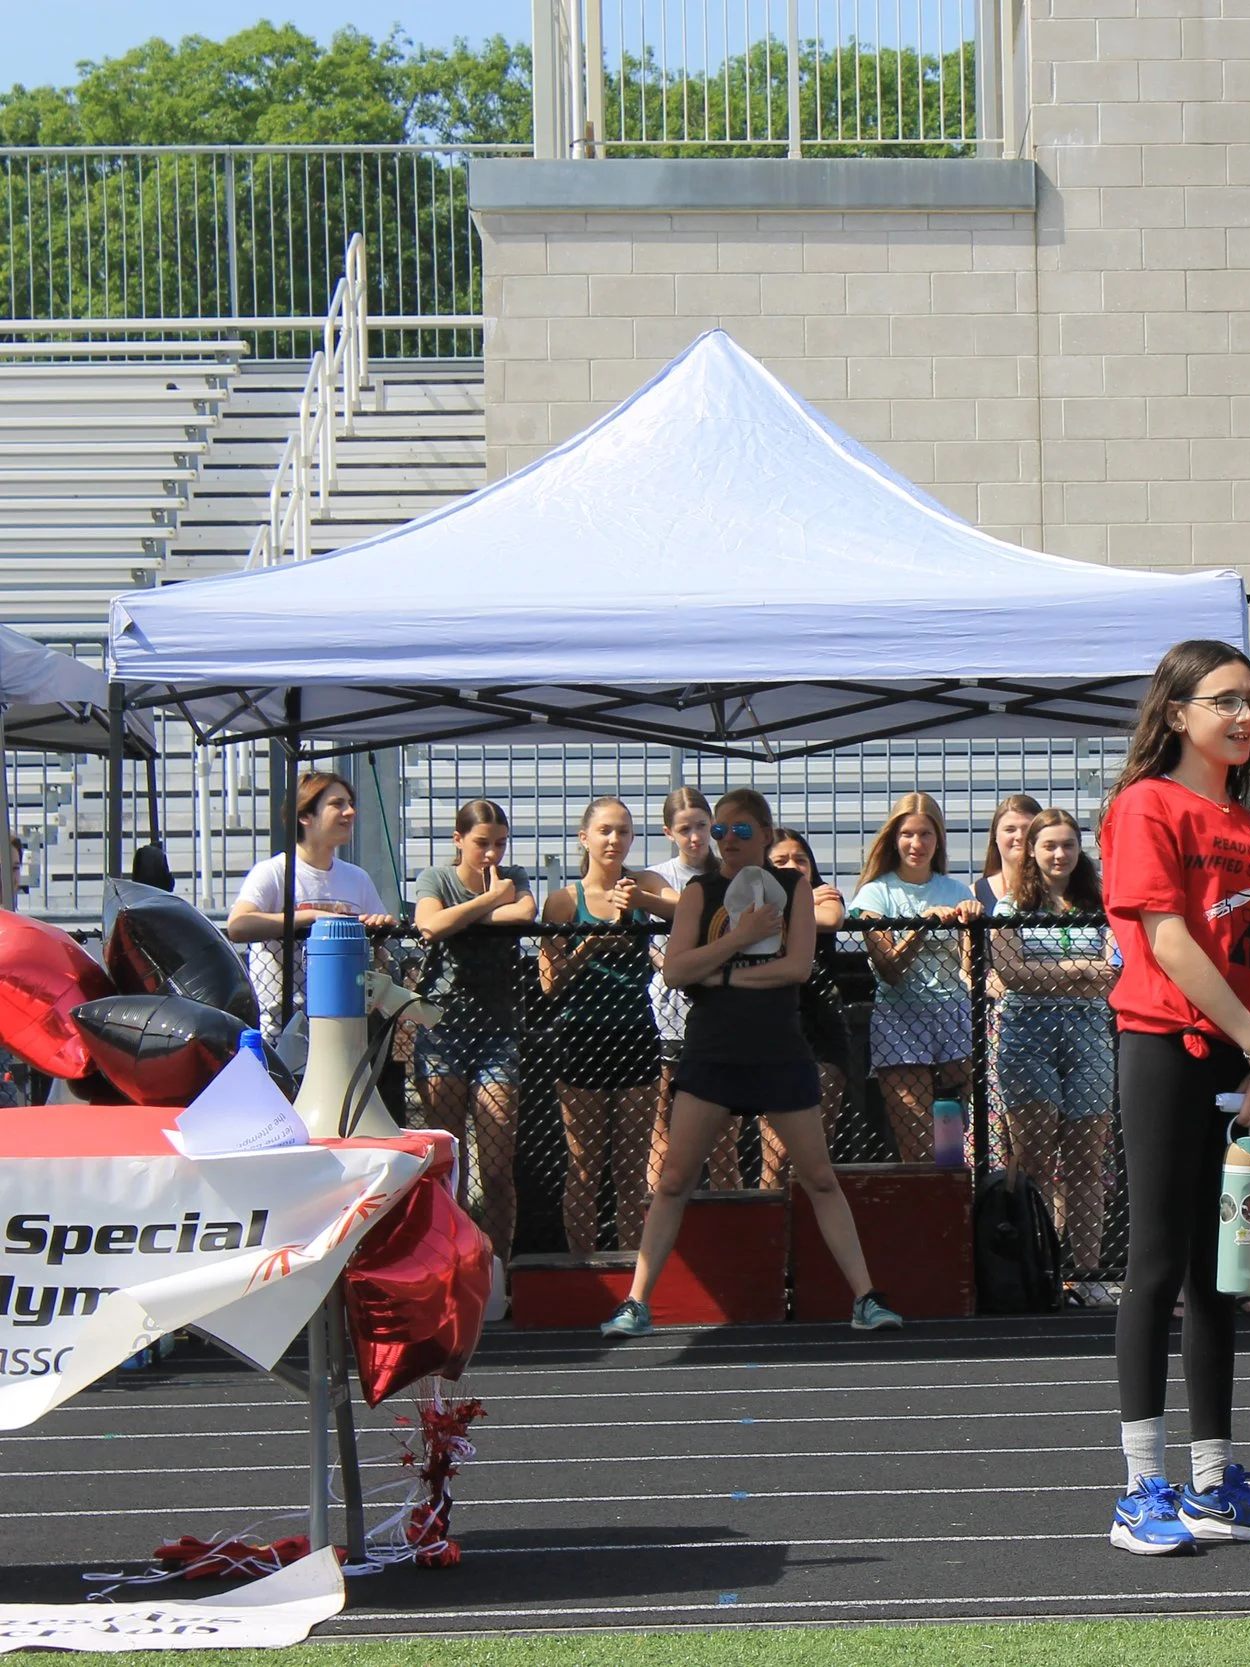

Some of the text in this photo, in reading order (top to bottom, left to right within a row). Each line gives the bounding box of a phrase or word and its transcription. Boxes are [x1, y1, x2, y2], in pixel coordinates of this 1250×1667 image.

[1183, 854, 1244, 875] UNIFIED
[273, 1112, 287, 1127] the
[4, 1209, 269, 1266] Special
